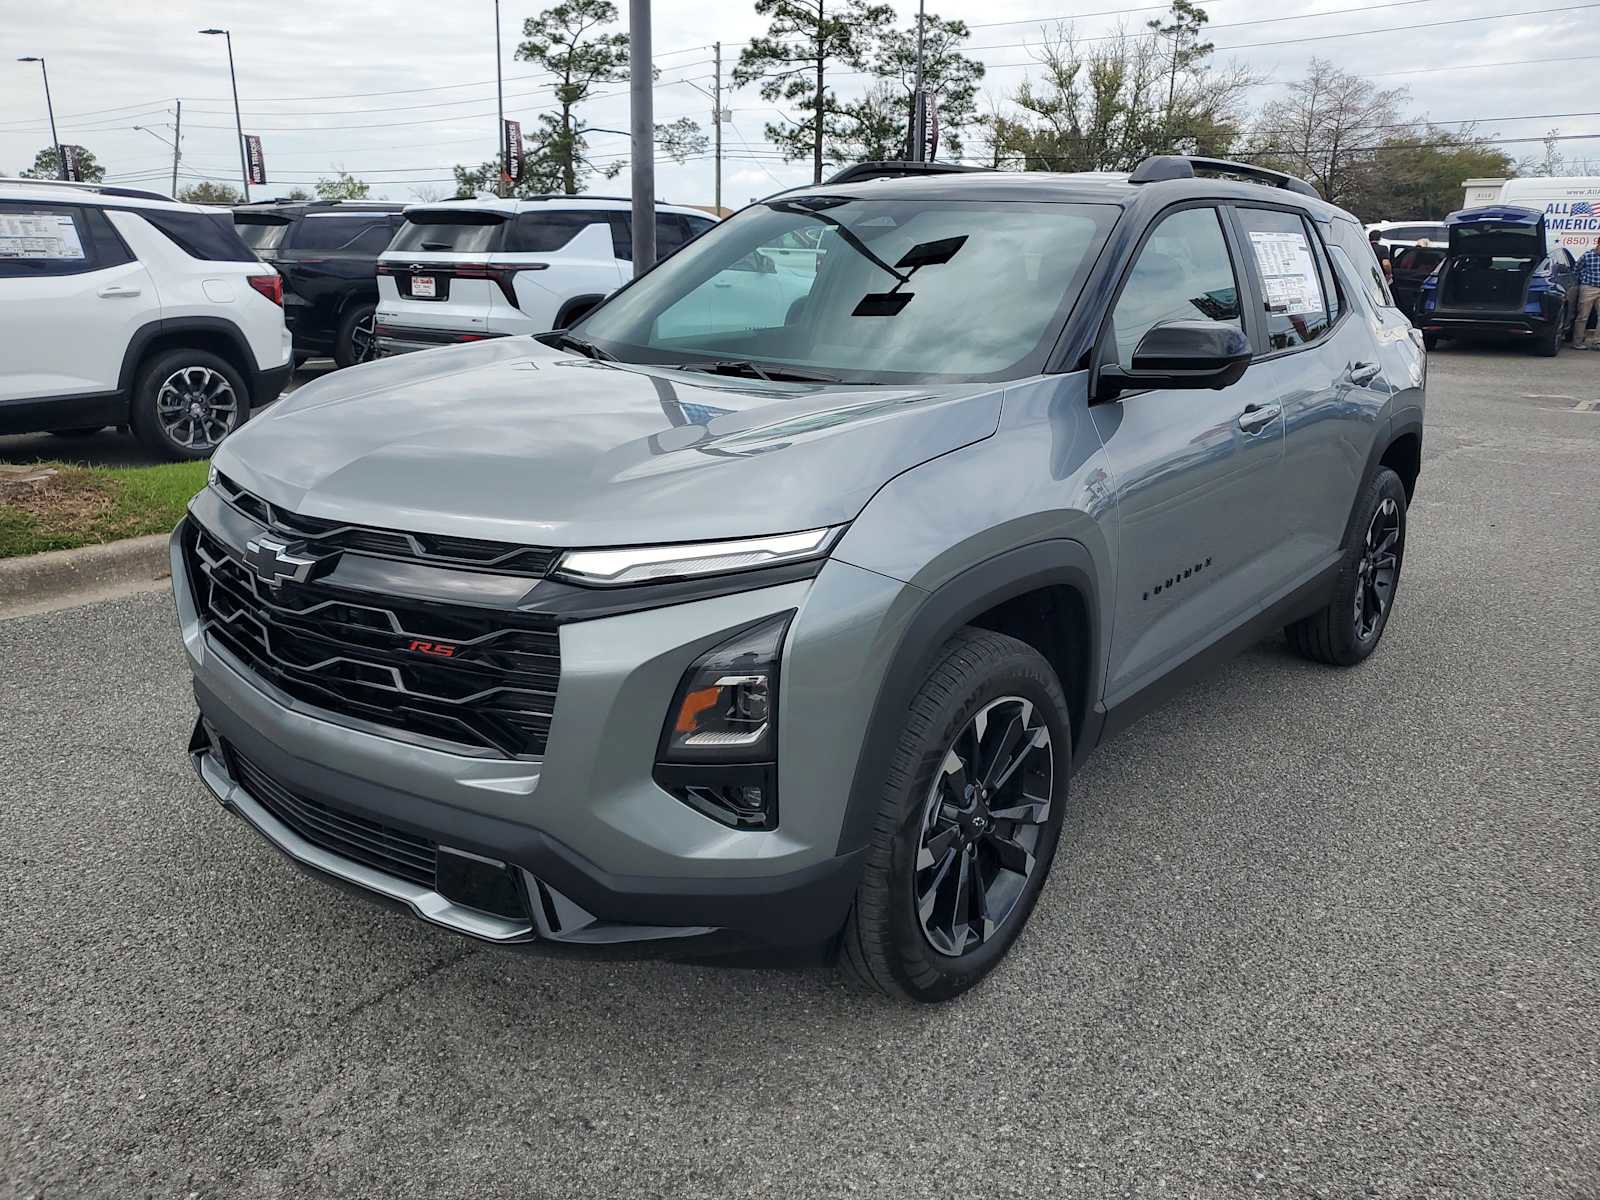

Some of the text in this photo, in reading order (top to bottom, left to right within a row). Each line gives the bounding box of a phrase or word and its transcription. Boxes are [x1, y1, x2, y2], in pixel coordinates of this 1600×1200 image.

[925, 95, 934, 140] TRUCKS
[508, 124, 519, 179] NEW TRUCKS
[252, 166, 261, 183] NEW
[1545, 202, 1570, 215] ALL
[1562, 236, 1590, 248] (850)
[408, 640, 456, 657] RS
